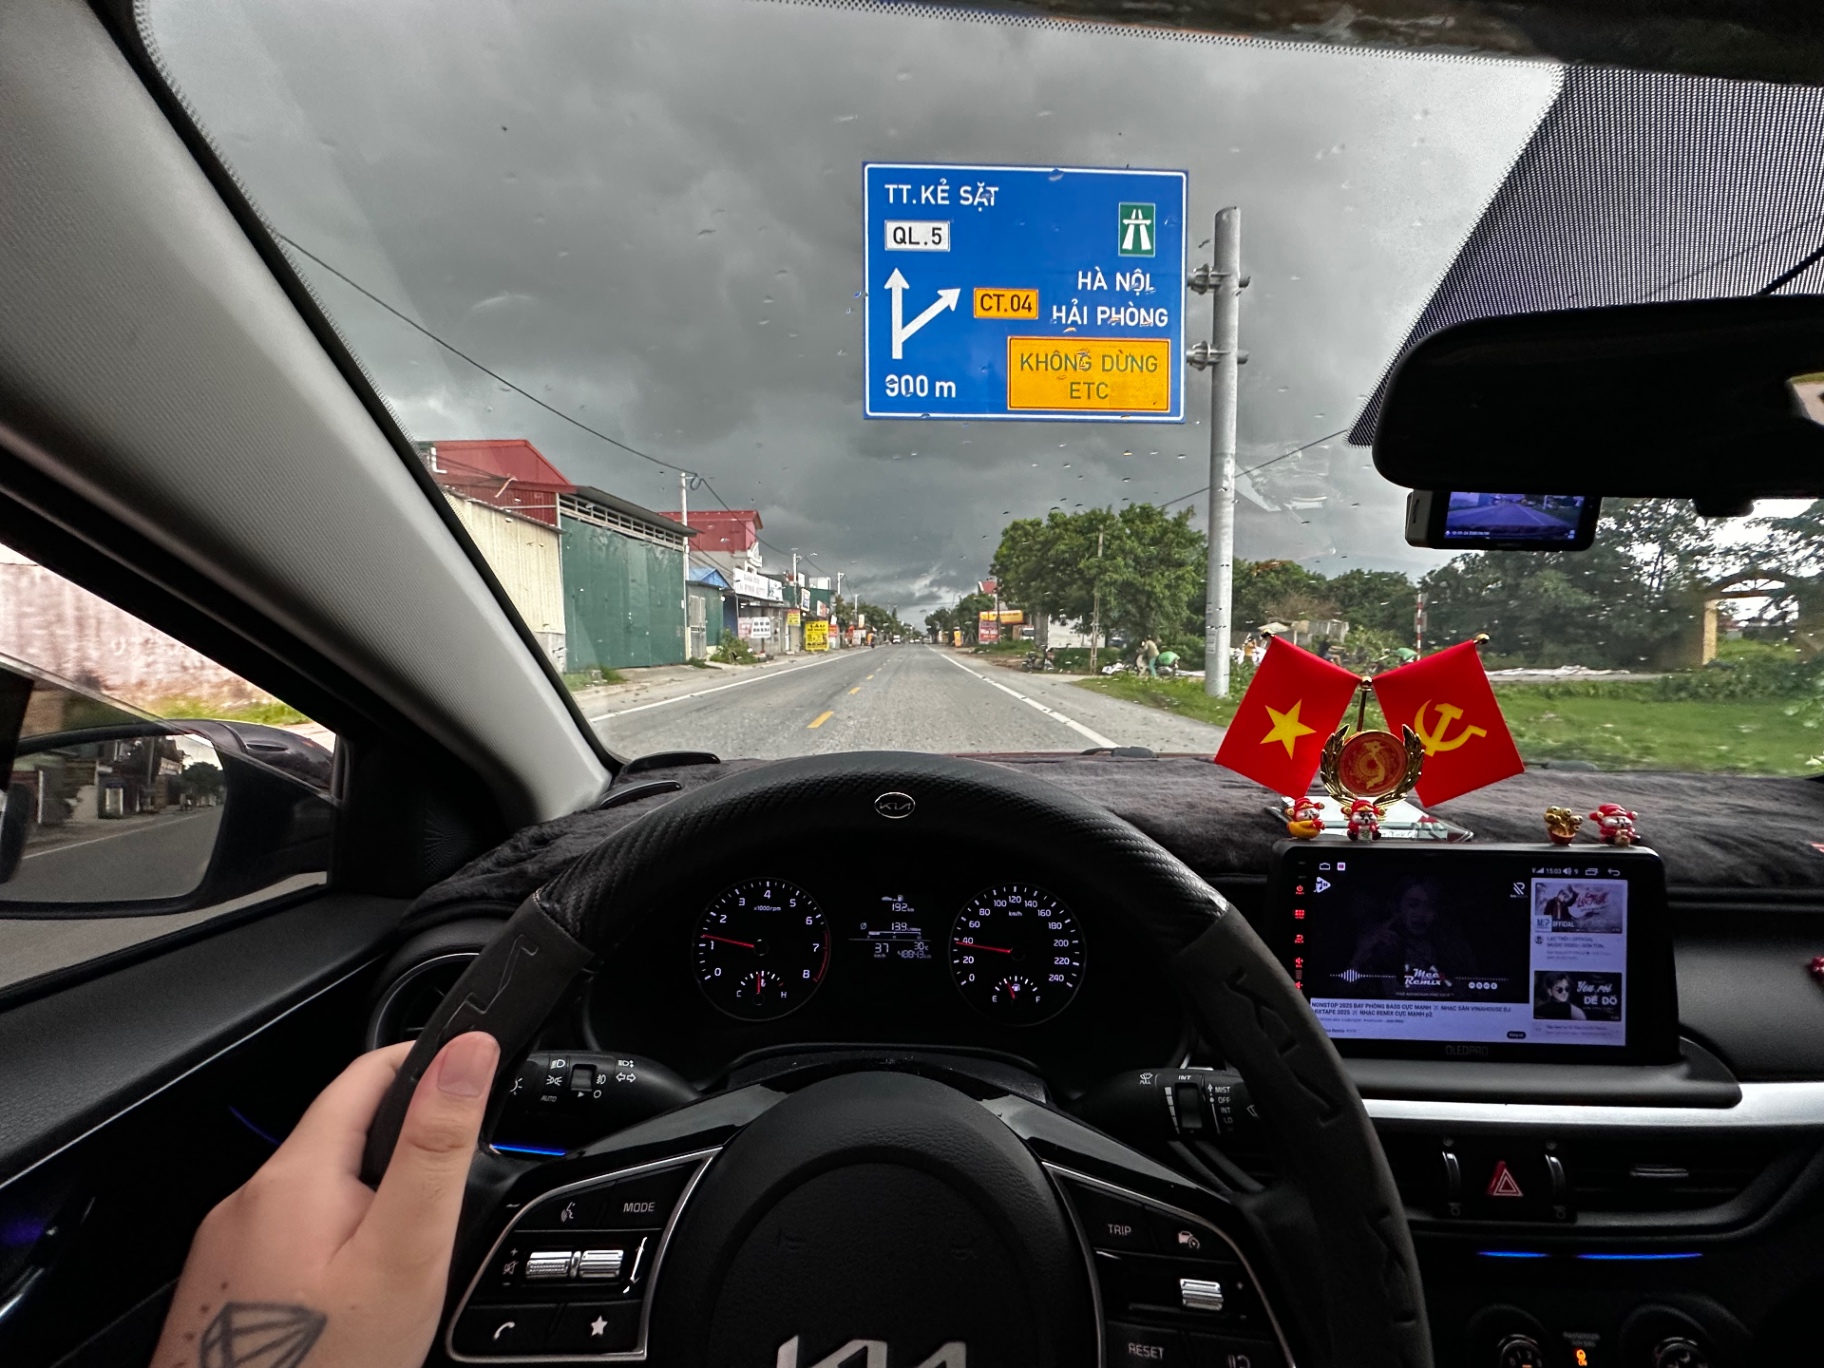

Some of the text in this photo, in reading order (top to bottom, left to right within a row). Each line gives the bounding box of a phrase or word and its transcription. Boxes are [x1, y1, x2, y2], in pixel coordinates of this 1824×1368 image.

[884, 178, 999, 212] TT.KẺ SẶT
[893, 226, 942, 246] QL.5
[1078, 266, 1108, 291] HÀ
[979, 293, 1033, 313] CT.04
[1052, 298, 1168, 328] HẢI PHÒNG
[1020, 349, 1158, 373] KHÔNG DỪNG
[935, 380, 957, 398] m
[1069, 381, 1109, 400] ETC
[1546, 867, 1562, 875] 15:03
[763, 889, 772, 899] 4
[738, 897, 746, 907] 3
[789, 898, 797, 908] 5
[993, 899, 1007, 908] 100
[1008, 895, 1022, 904] 120
[1024, 900, 1038, 908] 140
[753, 905, 782, 913] x1000rpm
[978, 908, 991, 916] 80
[1037, 909, 1052, 917] 160
[719, 914, 728, 924] 2
[805, 916, 813, 925] 6
[968, 920, 981, 928] 60
[1048, 922, 1063, 930] 180
[710, 940, 715, 950] 1
[962, 936, 974, 945] 40
[1053, 939, 1069, 947] 200
[812, 943, 820, 953] 7
[874, 942, 889, 954] 37
[962, 956, 975, 964] 20
[1053, 957, 1070, 965] 220
[713, 967, 722, 977] 0
[802, 969, 810, 979] 8
[968, 973, 975, 982] 0
[1048, 974, 1065, 982] 240
[780, 991, 788, 999] H
[991, 995, 998, 1003] E
[1035, 995, 1041, 1003] F
[540, 1094, 558, 1103] AUTO
[1217, 1096, 1231, 1104] OFF
[622, 1201, 657, 1213] MODE
[1106, 1223, 1132, 1236] TRIP
[1127, 1341, 1165, 1361] RESET
